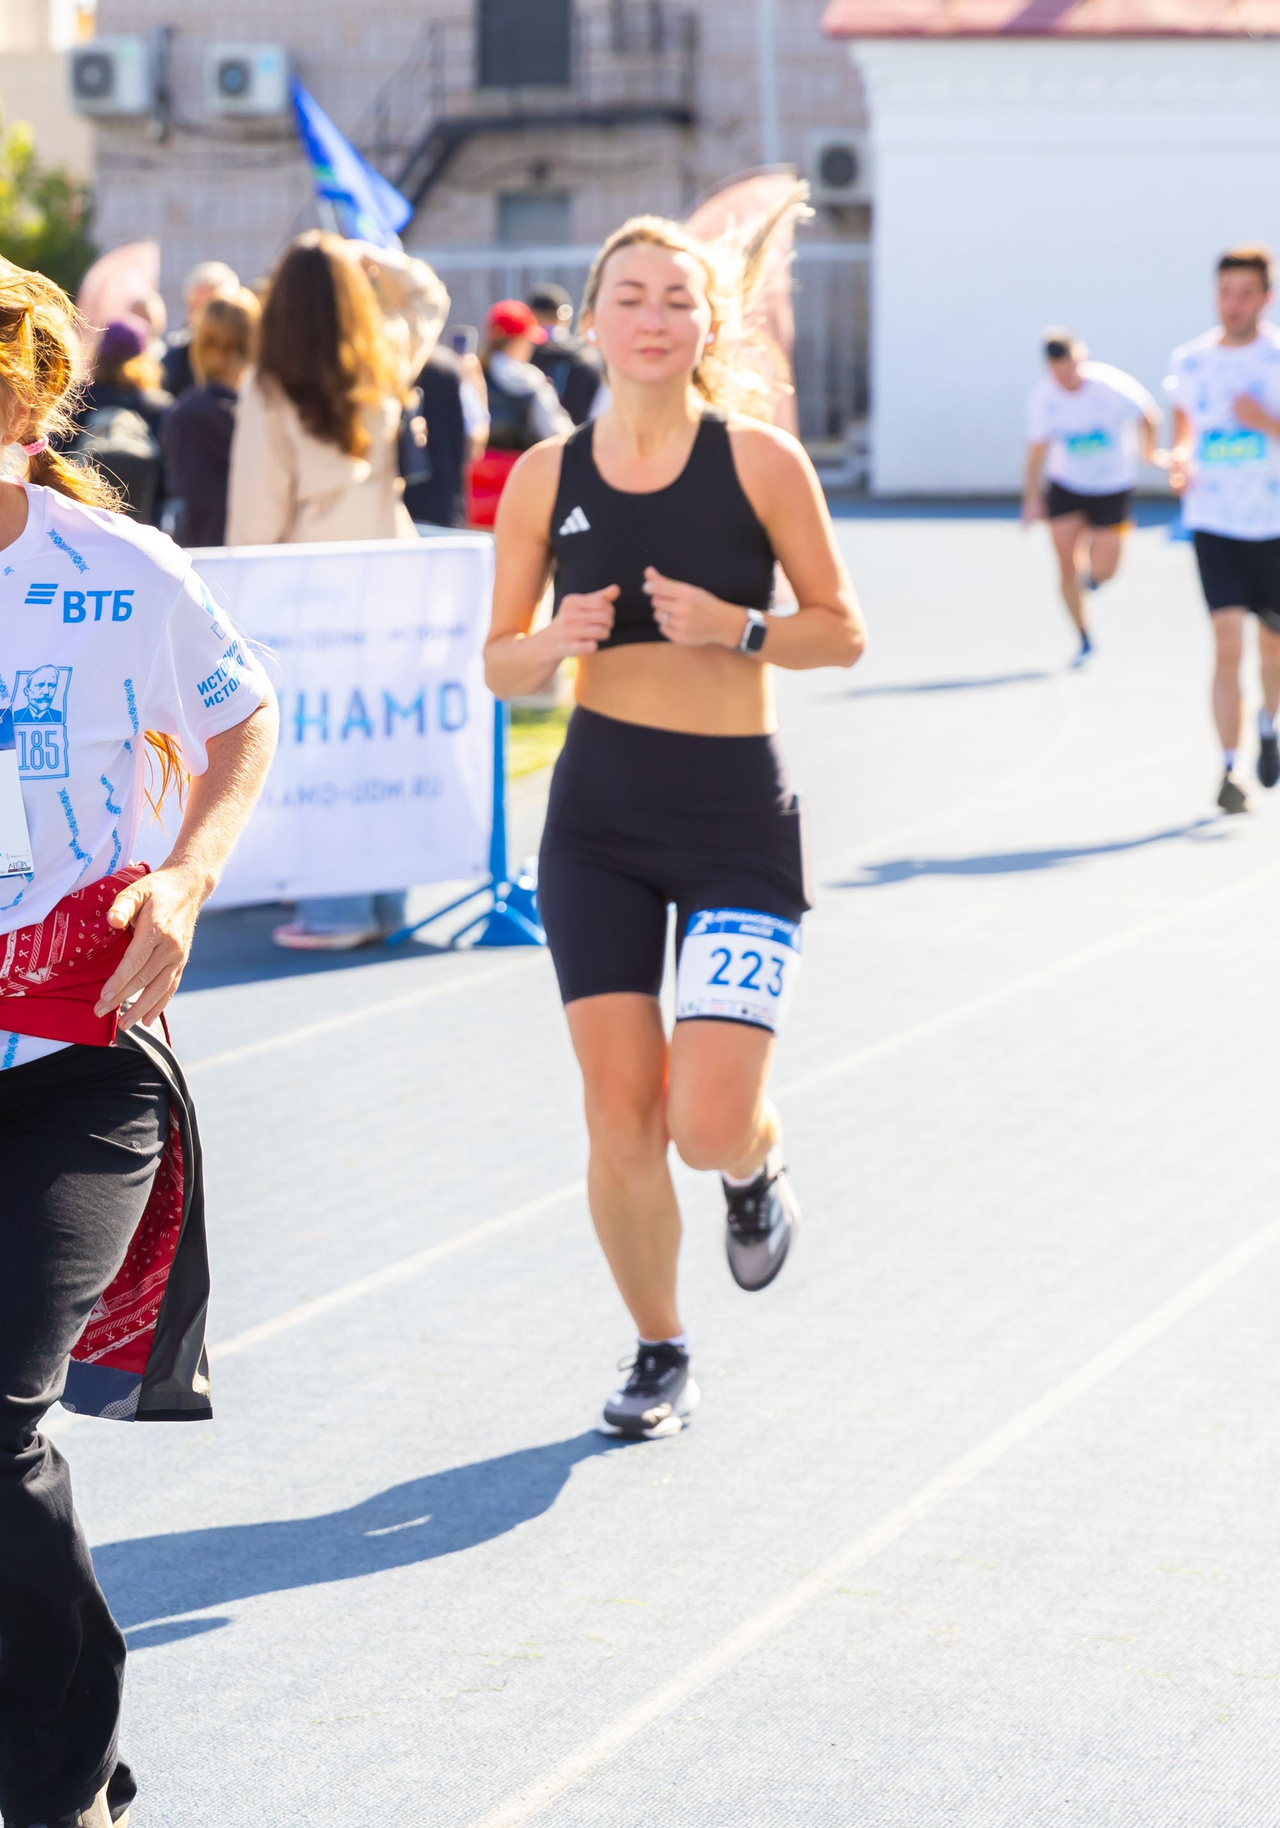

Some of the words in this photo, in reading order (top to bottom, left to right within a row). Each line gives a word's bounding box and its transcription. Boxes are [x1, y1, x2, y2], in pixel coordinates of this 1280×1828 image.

[62, 589, 136, 623] ВТБ
[204, 654, 244, 708] ИСТОРЯ
[17, 729, 61, 771] 185
[707, 948, 785, 997] 223
